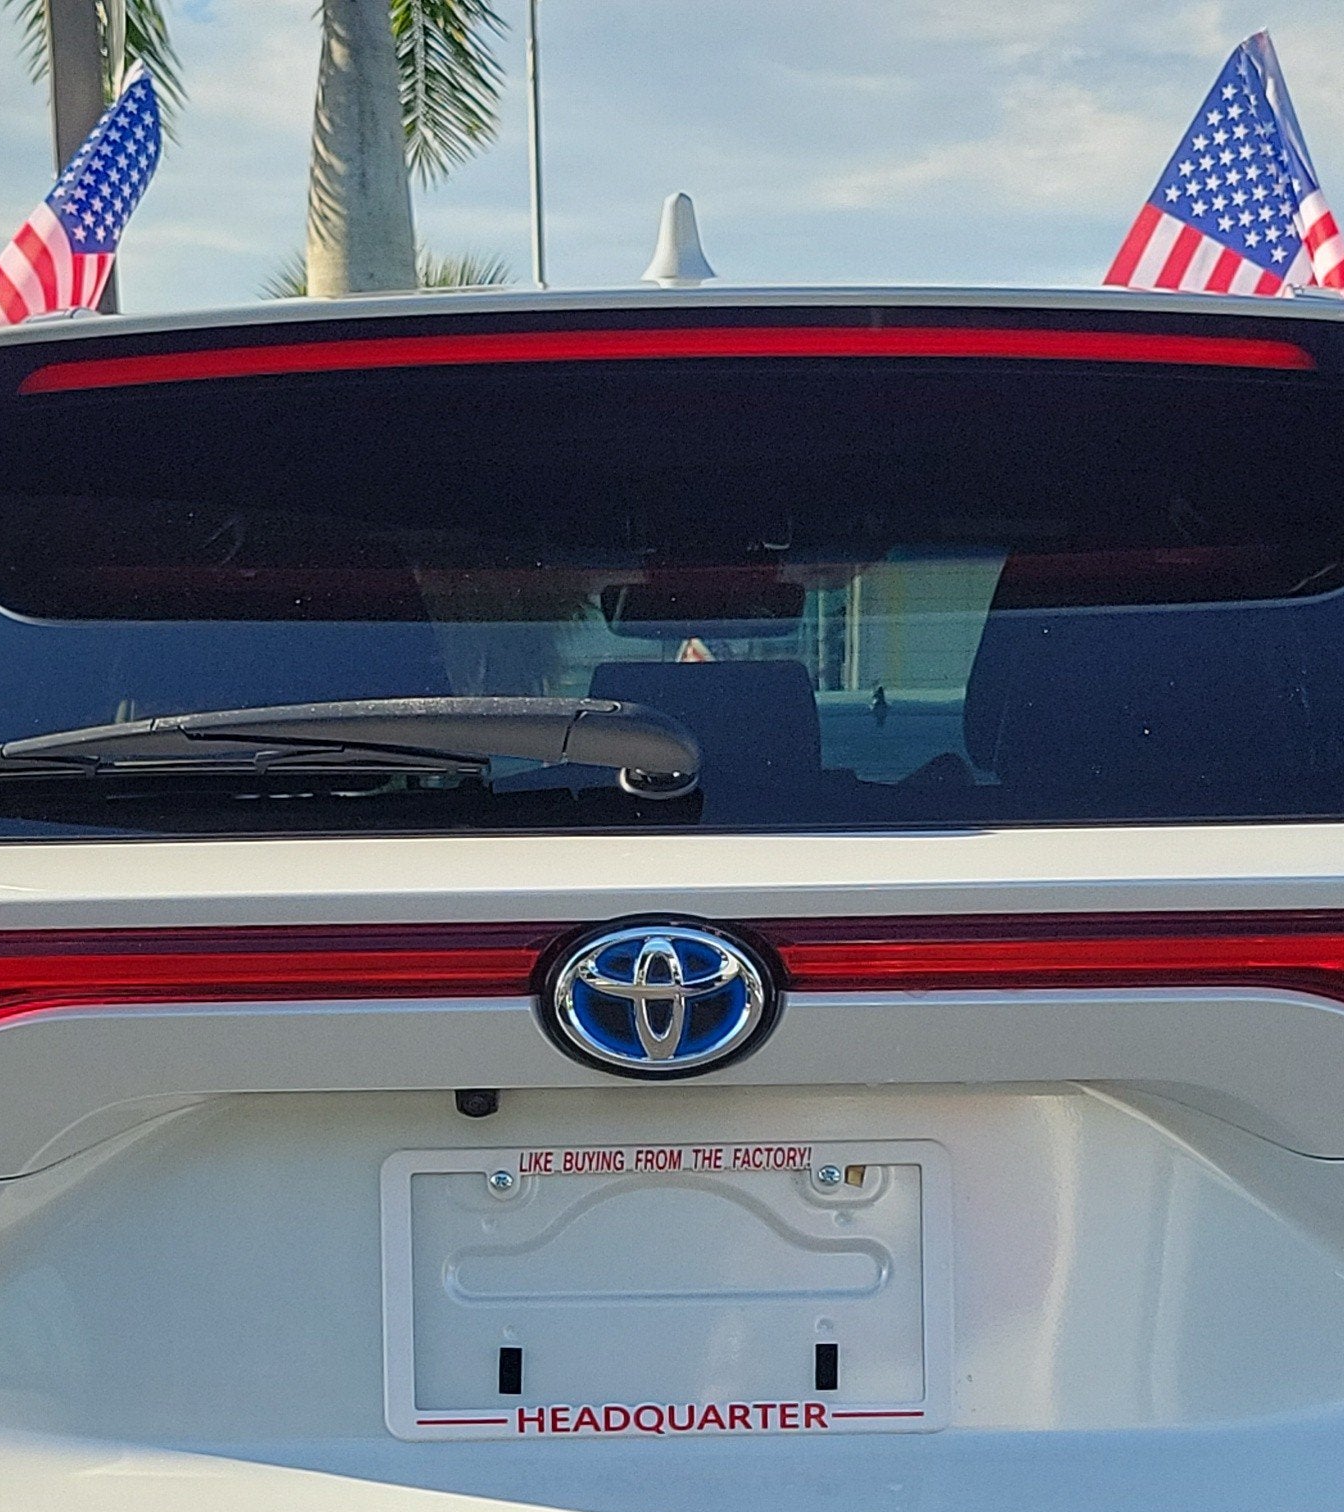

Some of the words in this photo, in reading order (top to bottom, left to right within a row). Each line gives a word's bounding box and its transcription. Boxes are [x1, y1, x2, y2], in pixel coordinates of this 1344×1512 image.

[519, 1151, 554, 1173] LIKE
[562, 1151, 625, 1173] BUYING
[634, 1149, 682, 1171] FROM
[692, 1148, 723, 1170] THE
[732, 1146, 813, 1170] FACTORY!
[517, 1402, 829, 1435] HEADQUARTER
